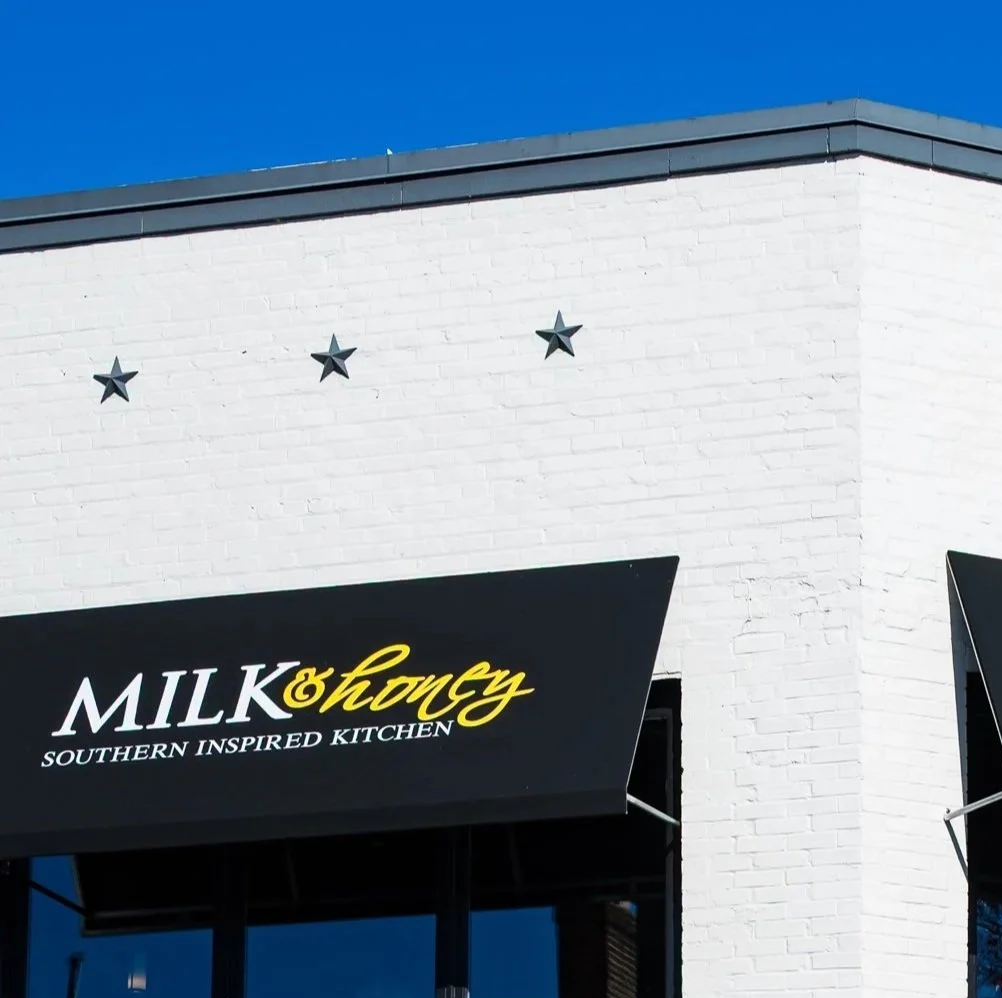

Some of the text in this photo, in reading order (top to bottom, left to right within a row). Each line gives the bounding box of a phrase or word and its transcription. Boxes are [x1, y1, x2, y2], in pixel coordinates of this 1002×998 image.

[50, 660, 302, 738] MILK
[40, 719, 456, 768] SOUTHERN INSPIRED KITCHEN
